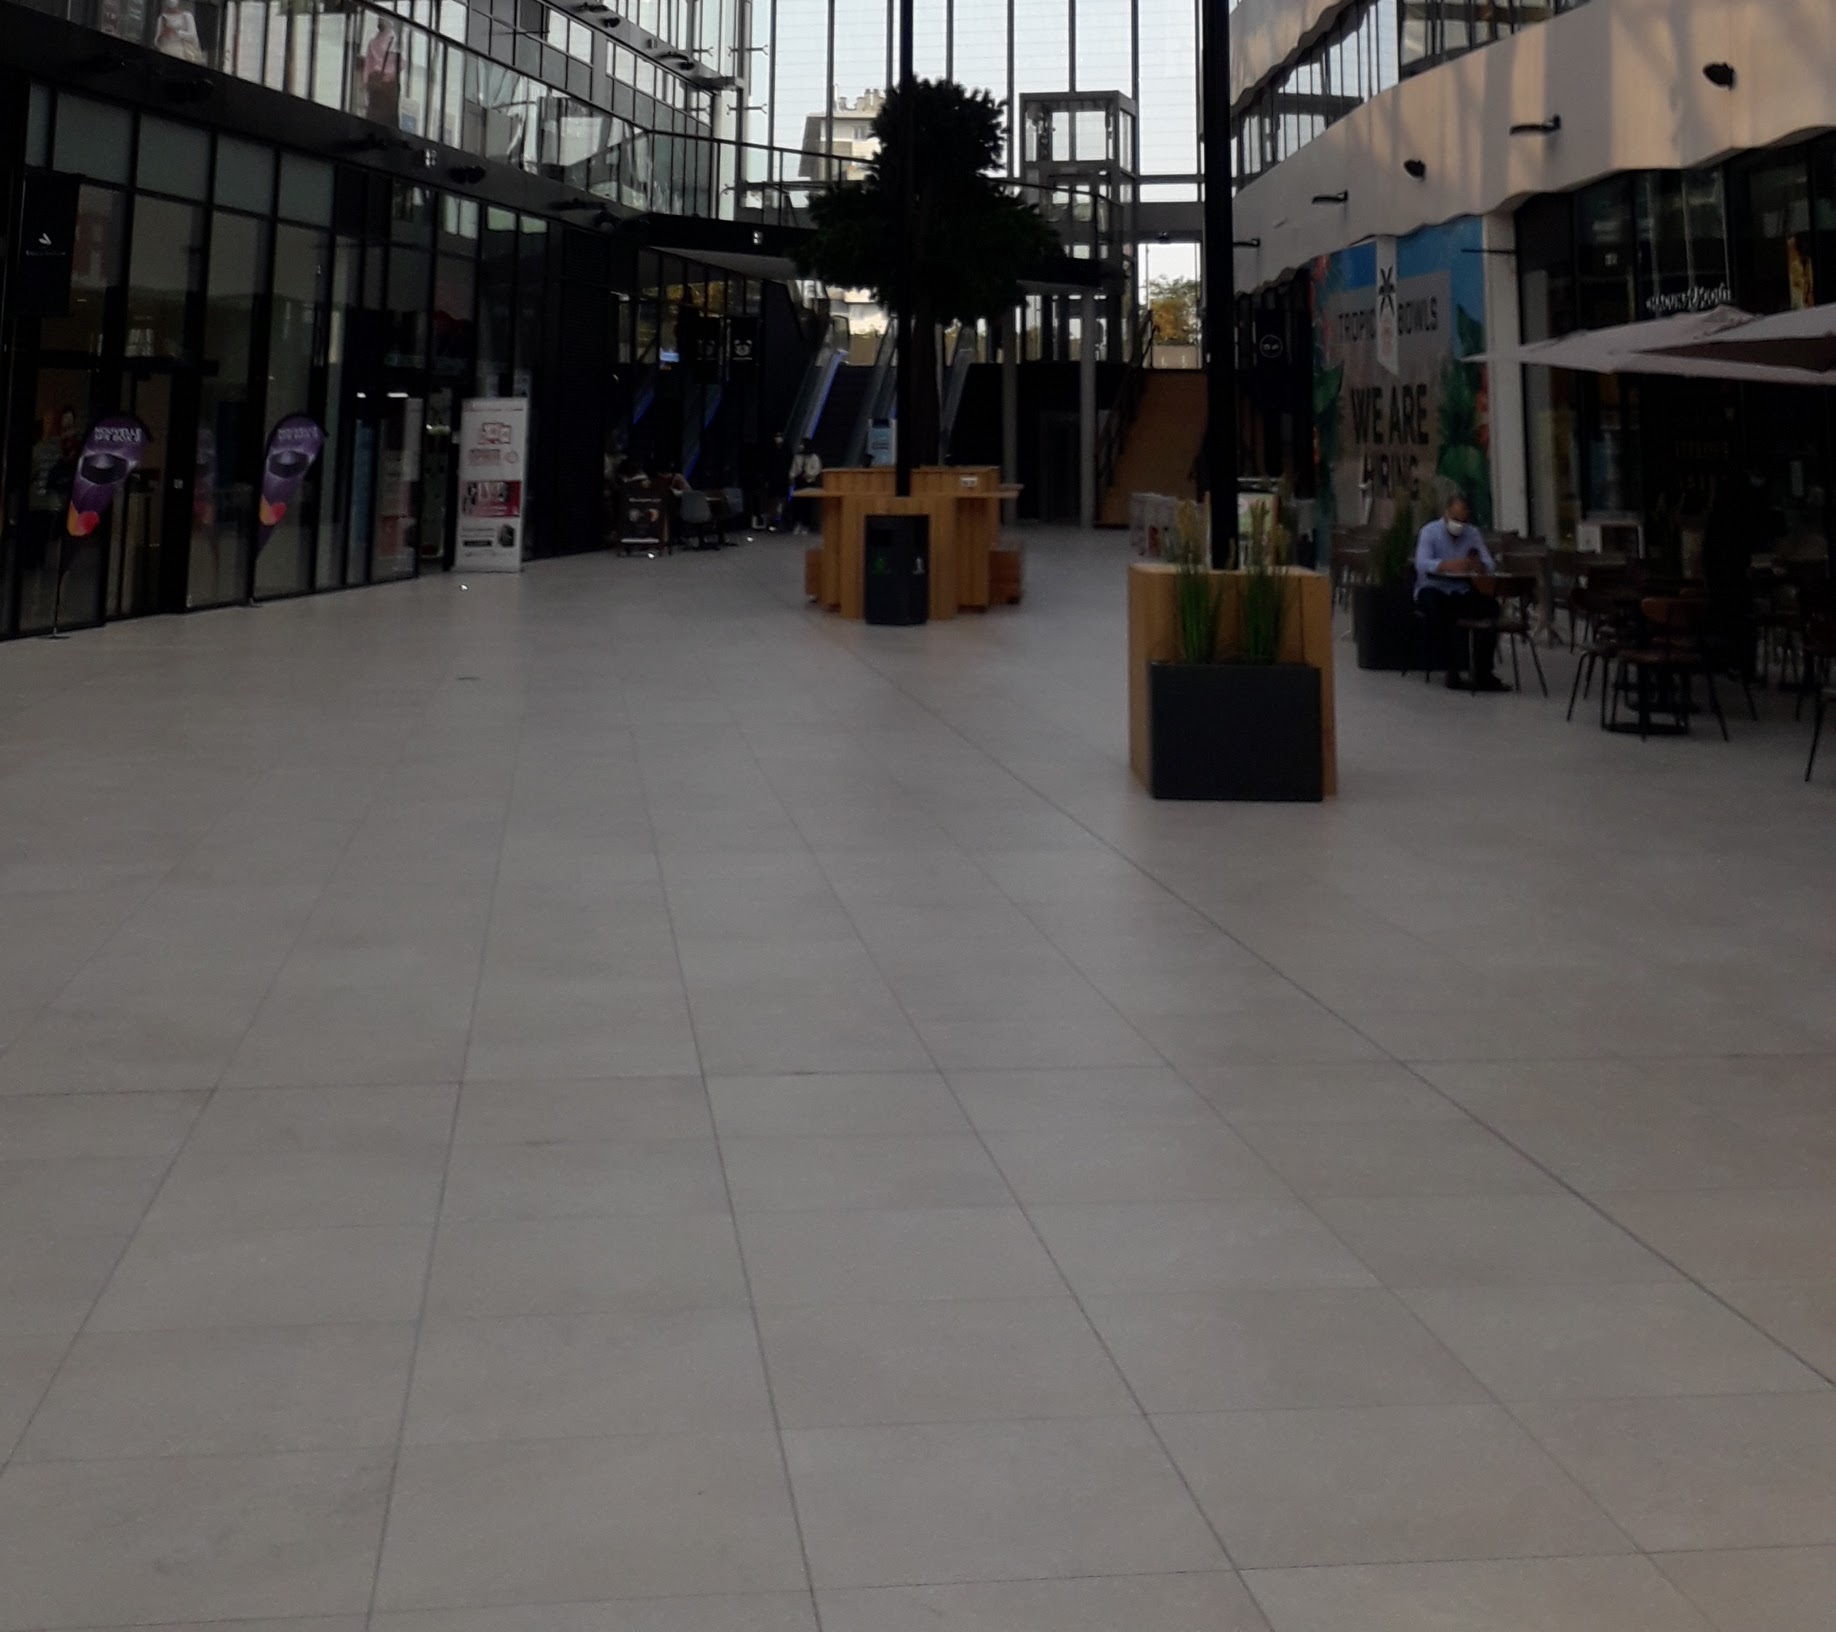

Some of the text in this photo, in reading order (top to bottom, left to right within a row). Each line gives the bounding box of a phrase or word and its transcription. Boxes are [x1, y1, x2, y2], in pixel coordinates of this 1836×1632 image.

[1398, 296, 1438, 337] BOWLS
[1351, 383, 1428, 445] WE ARE
